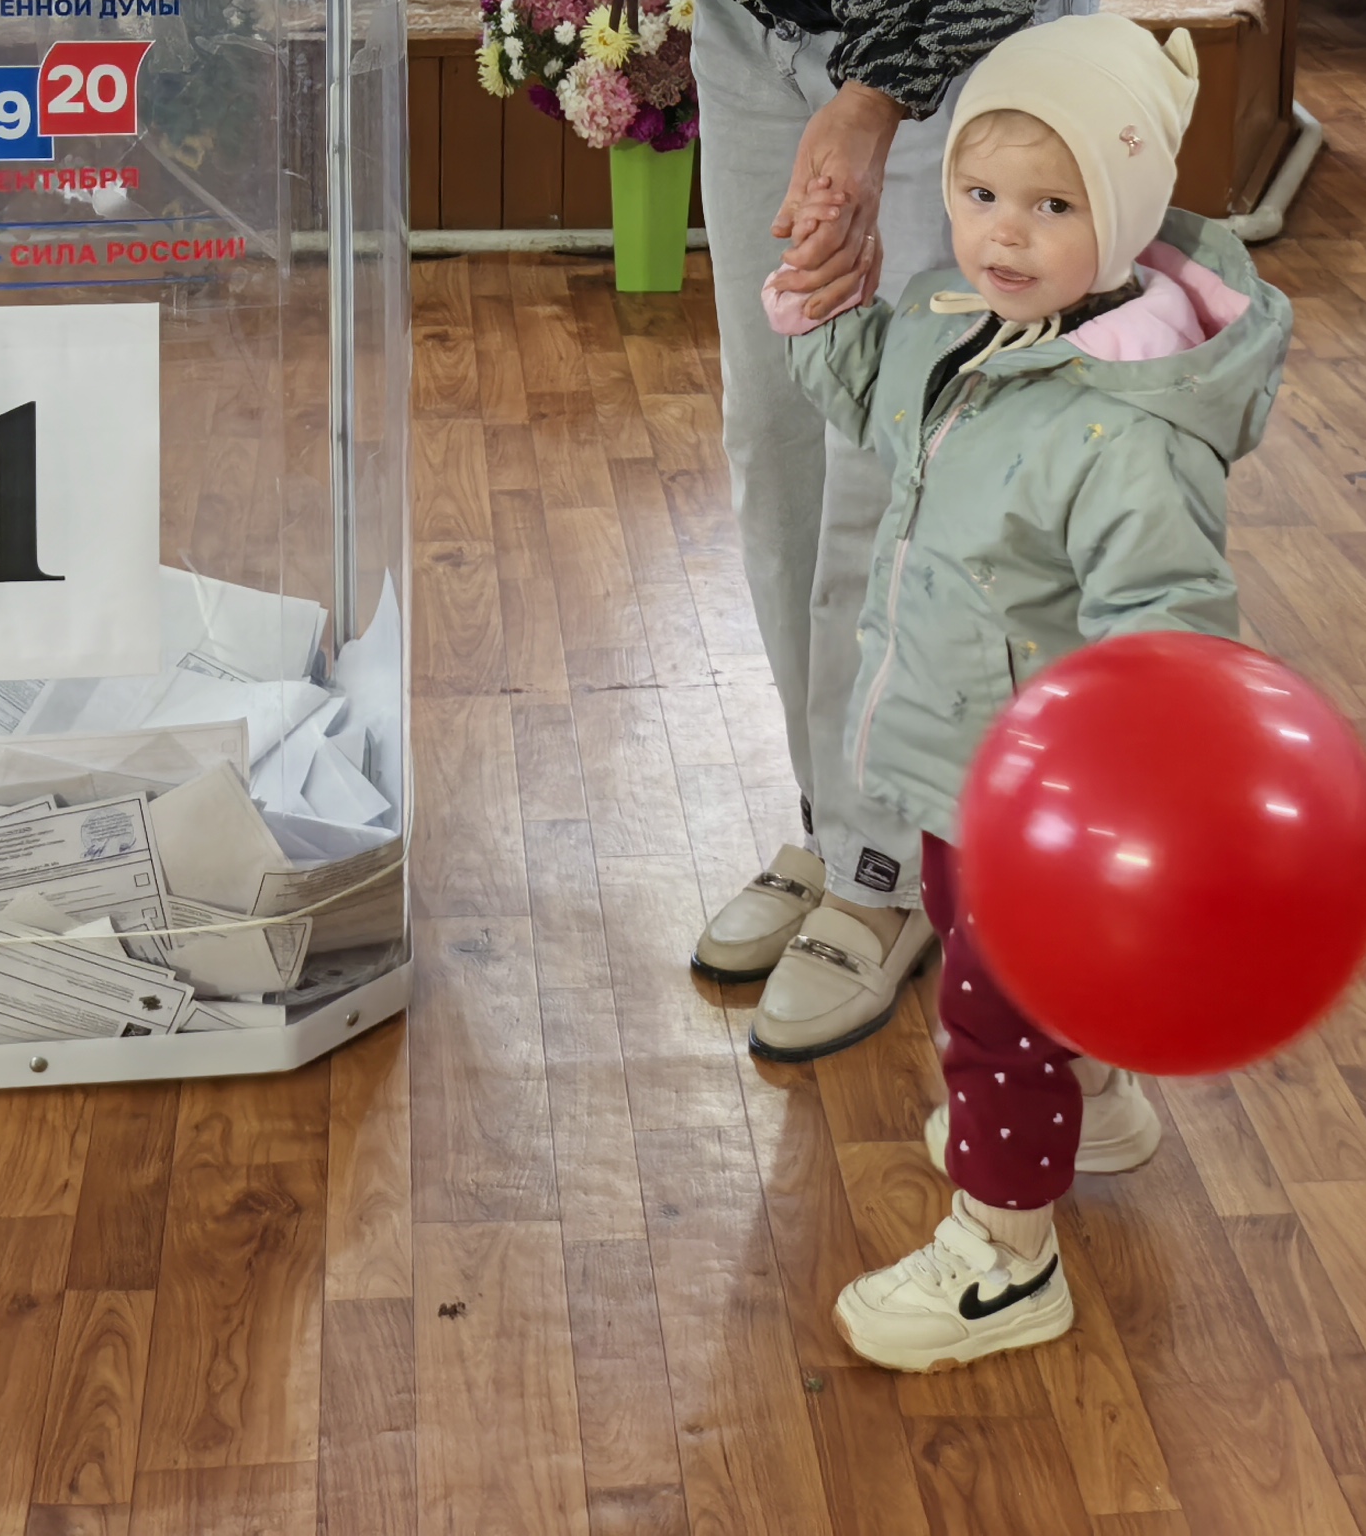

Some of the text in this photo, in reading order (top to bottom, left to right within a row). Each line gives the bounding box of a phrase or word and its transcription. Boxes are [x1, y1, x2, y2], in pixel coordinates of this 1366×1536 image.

[47, 64, 128, 114] 20
[10, 242, 98, 265] СИЛА
[106, 238, 247, 264] РОССИИ!
